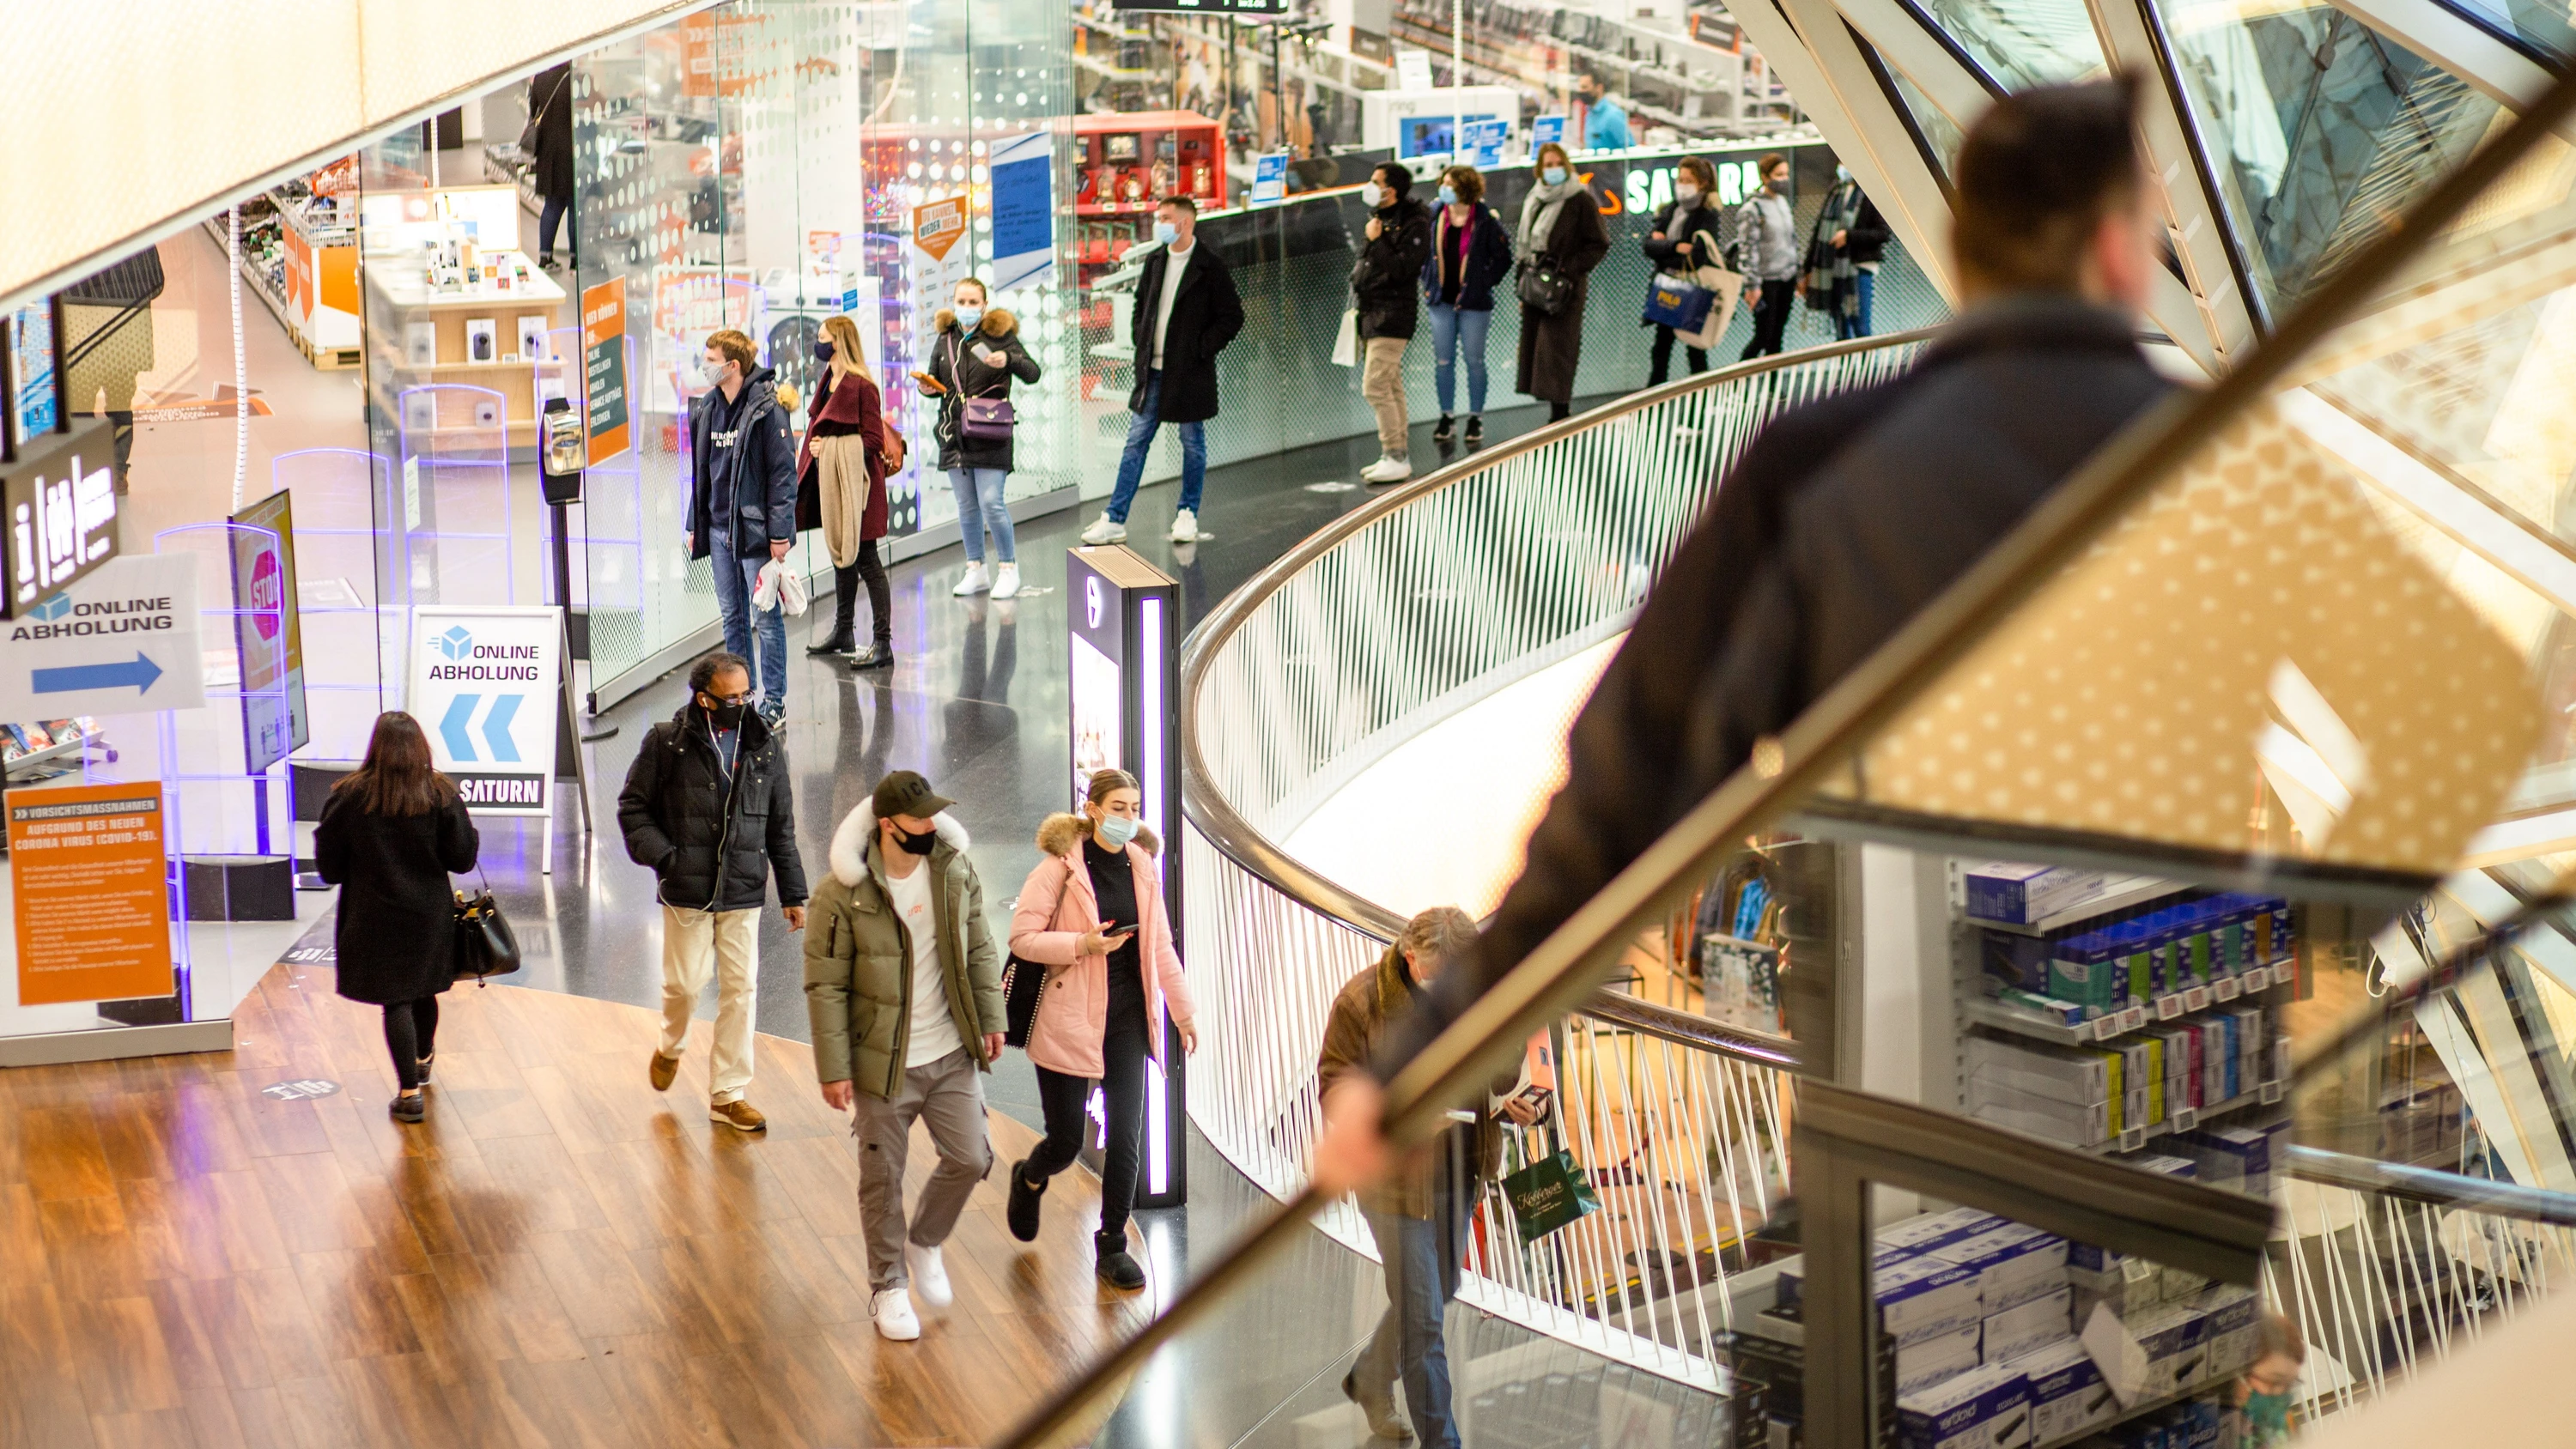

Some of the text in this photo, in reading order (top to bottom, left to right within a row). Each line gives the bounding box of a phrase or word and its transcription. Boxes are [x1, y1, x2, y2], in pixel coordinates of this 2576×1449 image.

[1625, 160, 1763, 215] SARN
[920, 219, 940, 238] WIEDER
[586, 310, 598, 326] HIER
[73, 597, 171, 616] ONLINE
[10, 615, 173, 641] ABHOLUNG
[473, 646, 539, 659] ONLINE
[429, 665, 538, 681] ABHOLUNG
[459, 779, 539, 803] SATURN
[29, 799, 155, 818] VORSICHTSMASSNAHMEN
[27, 816, 145, 835] AUFGRUND DES NEUEN
[15, 838, 59, 851] CORONA
[61, 834, 94, 848] VIRUS
